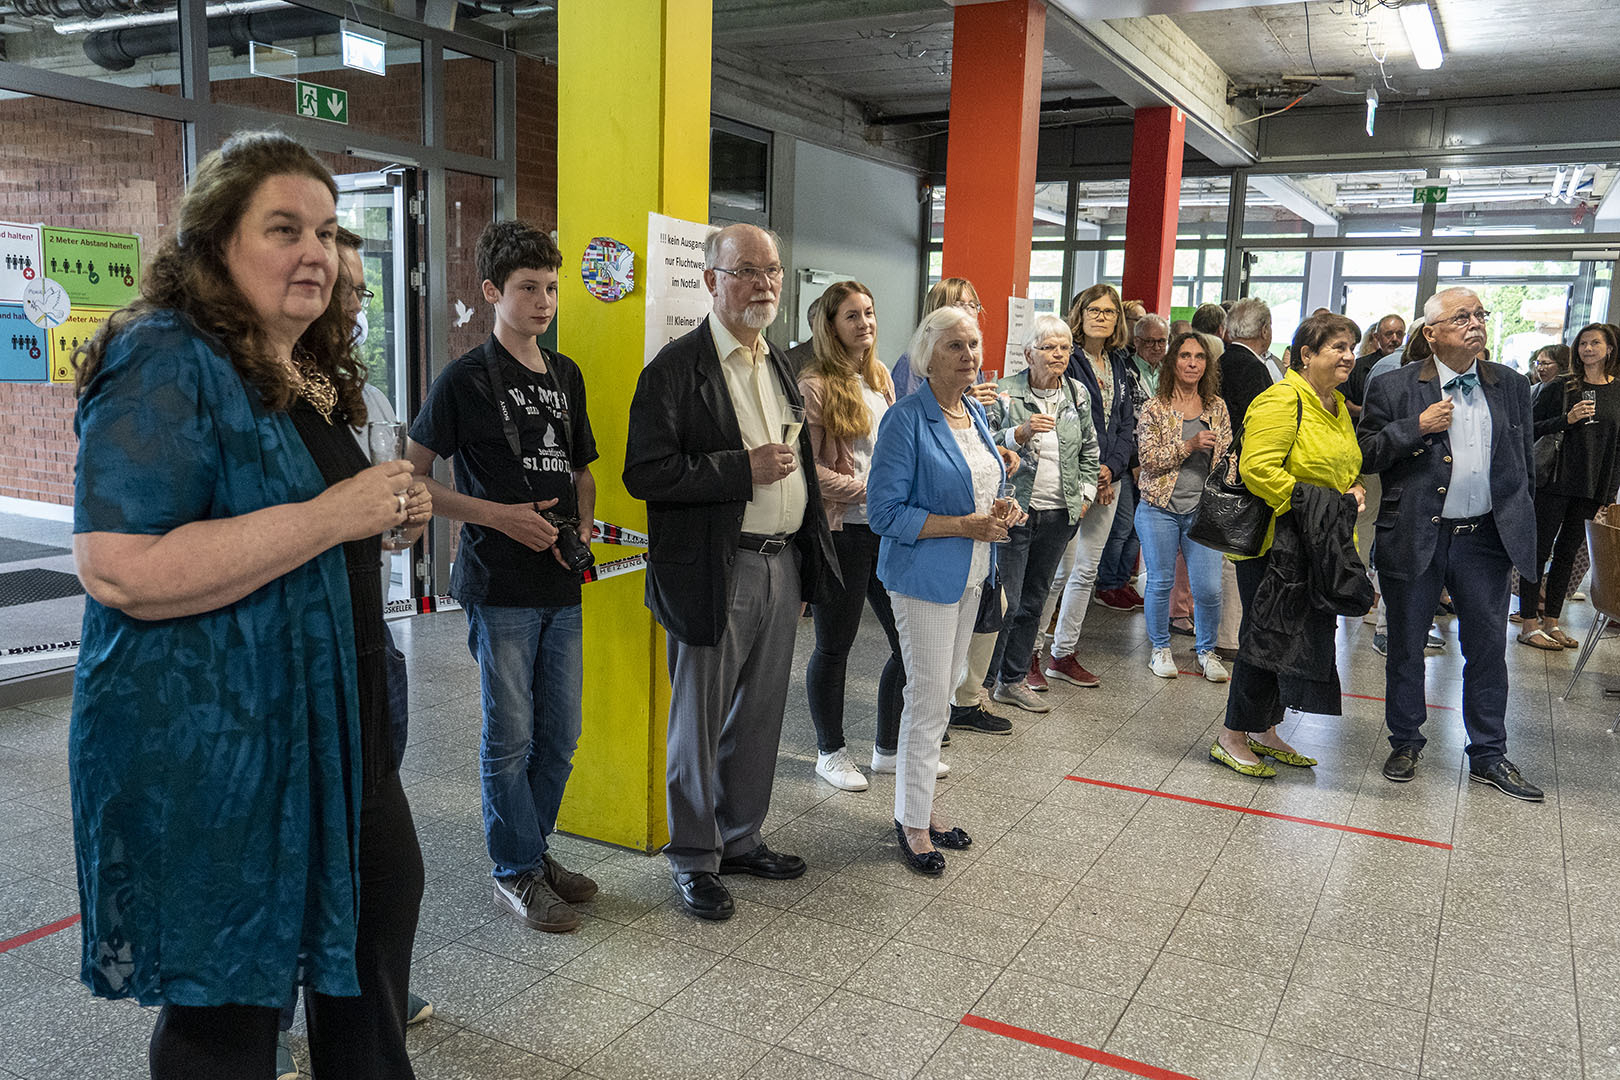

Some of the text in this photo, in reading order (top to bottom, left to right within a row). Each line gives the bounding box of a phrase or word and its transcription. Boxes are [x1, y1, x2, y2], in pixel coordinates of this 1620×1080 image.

[7, 232, 33, 241] halten!
[56, 236, 78, 245] Meter
[80, 239, 108, 248] Abstand
[109, 242, 134, 250] halten!
[667, 235, 679, 246] kein
[681, 237, 705, 251] Ausgang
[665, 257, 705, 271] nur Fluchtweg
[672, 277, 700, 289] im Notfall
[674, 316, 696, 327] Kleiner
[500, 401, 510, 421] SONY
[600, 560, 642, 574] HEIZUNG
